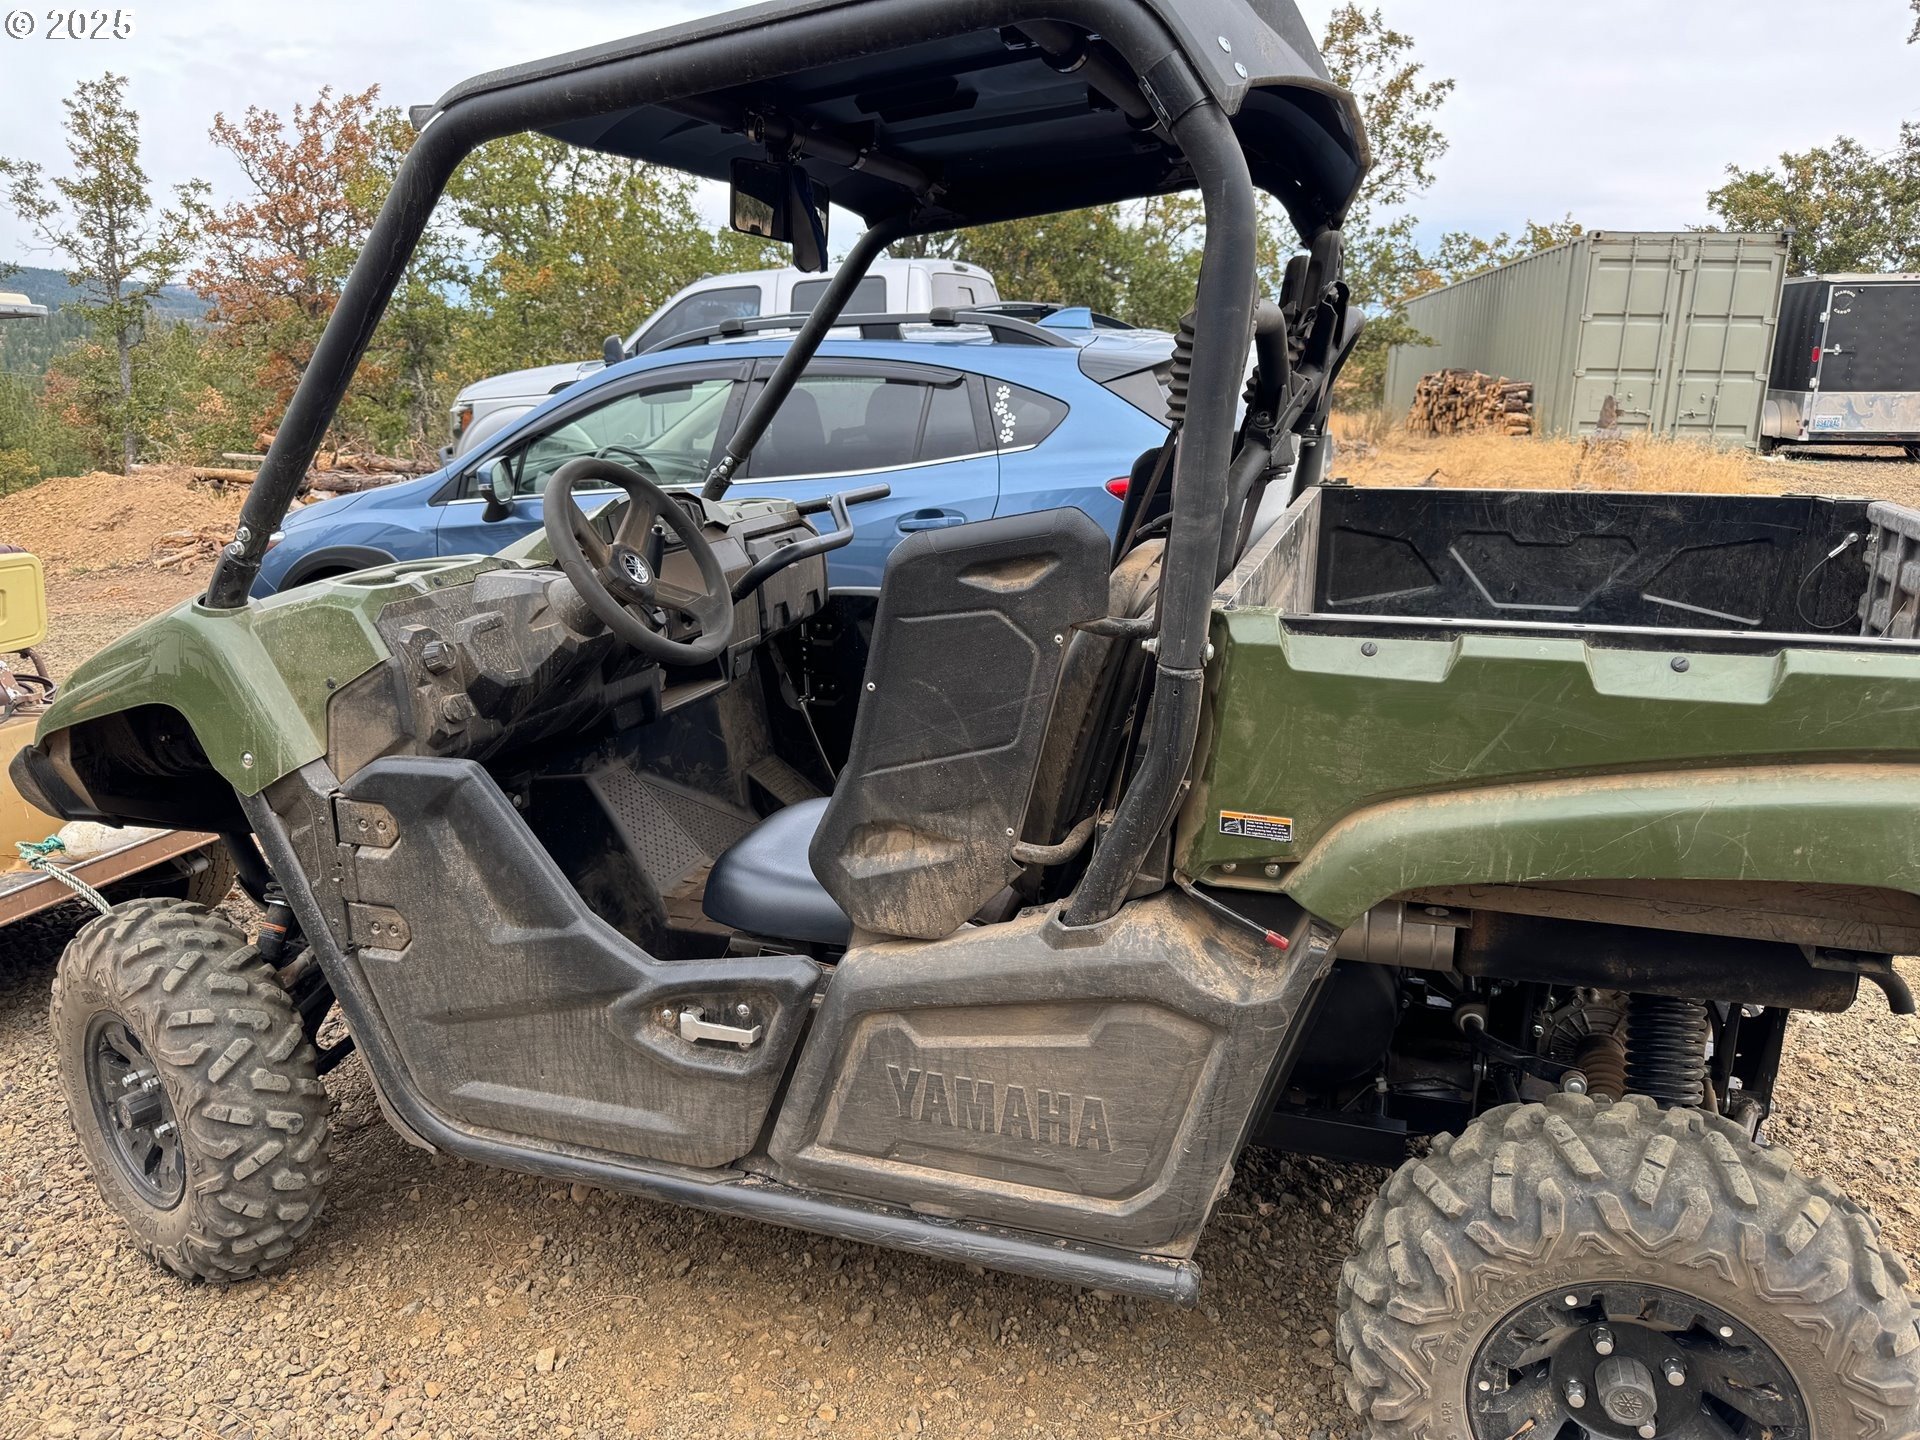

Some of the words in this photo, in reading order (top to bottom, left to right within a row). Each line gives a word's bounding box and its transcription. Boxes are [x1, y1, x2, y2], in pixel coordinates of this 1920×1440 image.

[886, 1064, 1113, 1152] YAMAHA
[1441, 1261, 1582, 1365] BIGHORN
[1441, 1401, 1453, 1424] 4PR
